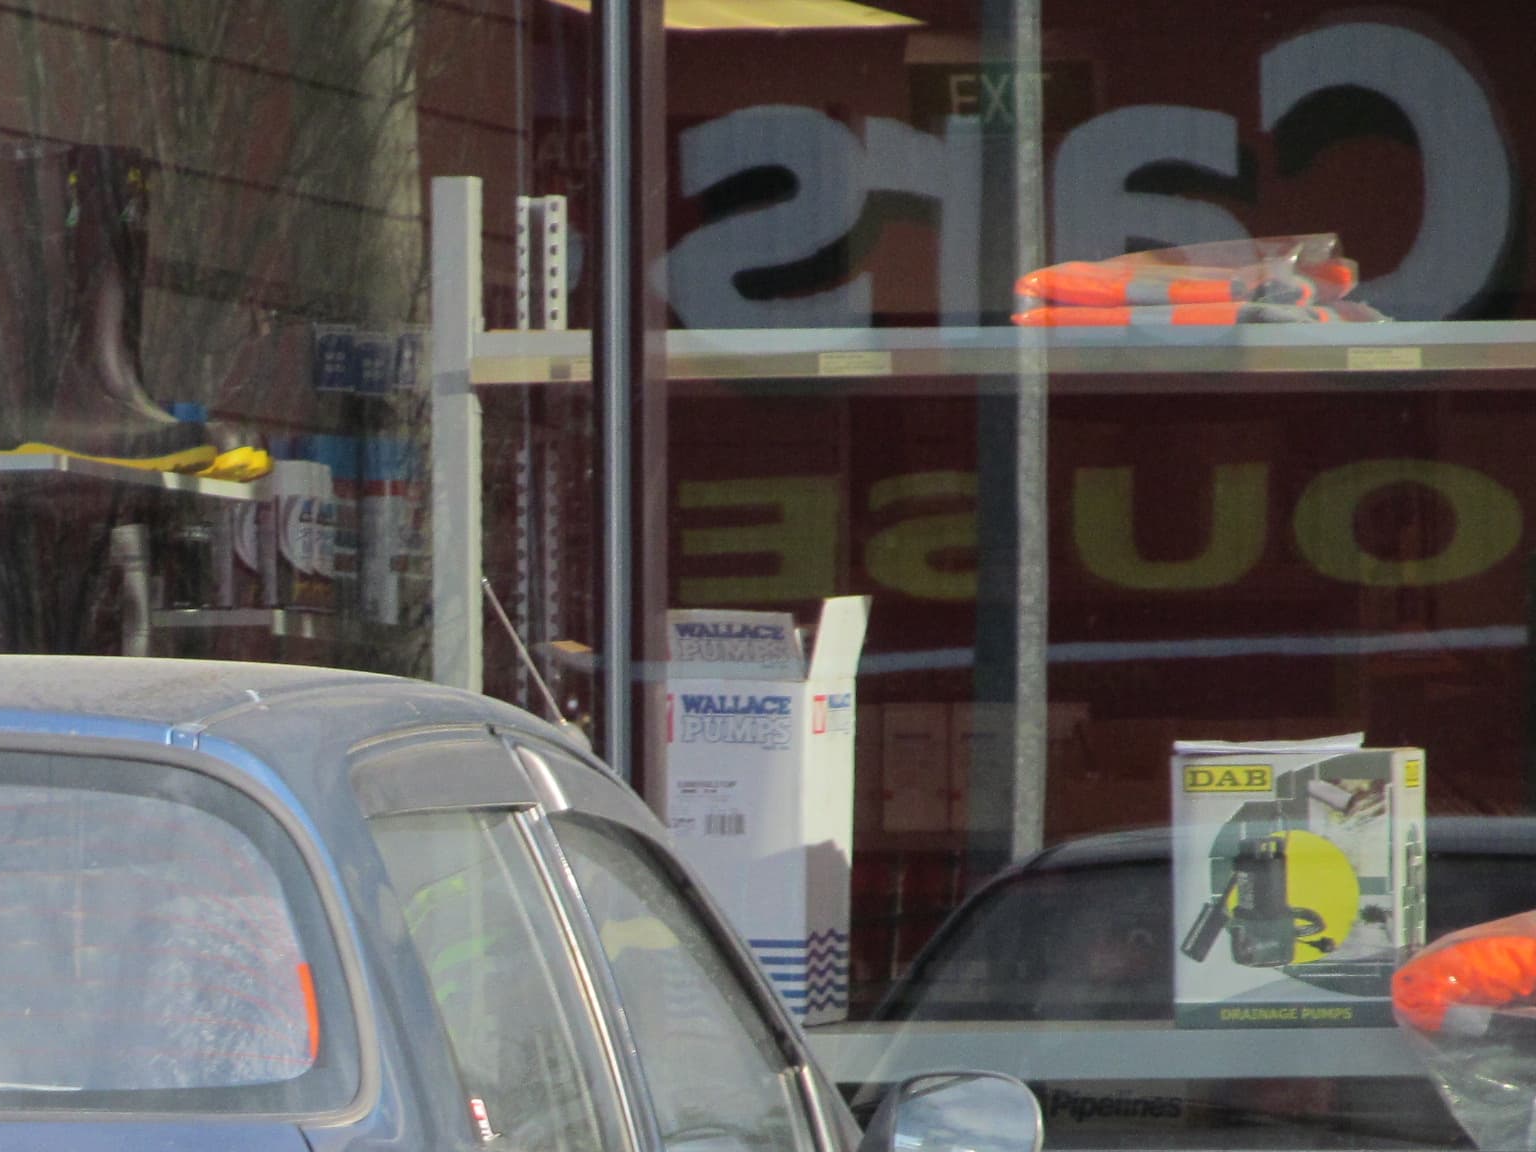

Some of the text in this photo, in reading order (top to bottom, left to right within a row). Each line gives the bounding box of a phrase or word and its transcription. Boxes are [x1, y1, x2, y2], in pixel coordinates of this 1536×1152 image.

[950, 73, 1052, 123] EXT
[674, 621, 784, 640] WALLACE
[676, 640, 791, 662] PUMPS
[680, 694, 792, 715] WALLACE
[680, 716, 792, 745] PUMPS
[1188, 768, 1269, 788] DAB
[1220, 1006, 1354, 1021] DRAINAGE PUMPS
[1050, 1088, 1183, 1123] Pipelines
